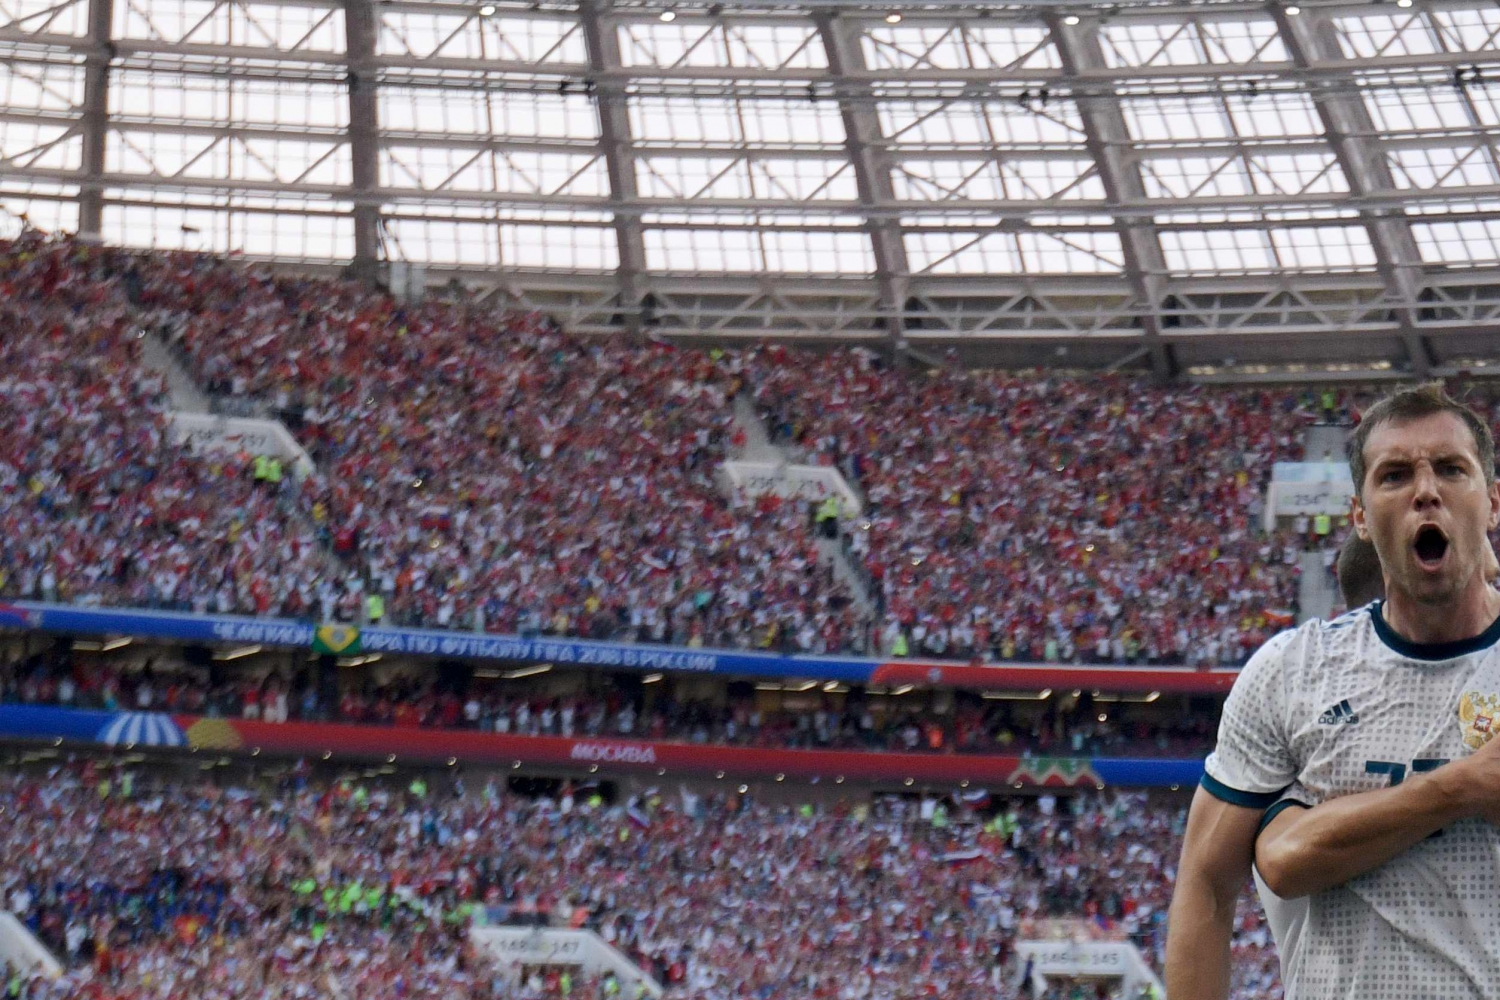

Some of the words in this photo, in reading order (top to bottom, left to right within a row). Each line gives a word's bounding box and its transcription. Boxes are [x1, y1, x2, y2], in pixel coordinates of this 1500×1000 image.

[213, 622, 314, 646] ЧЕМПИОН
[360, 631, 402, 651] ИРА
[571, 742, 656, 763] МОСКВА
